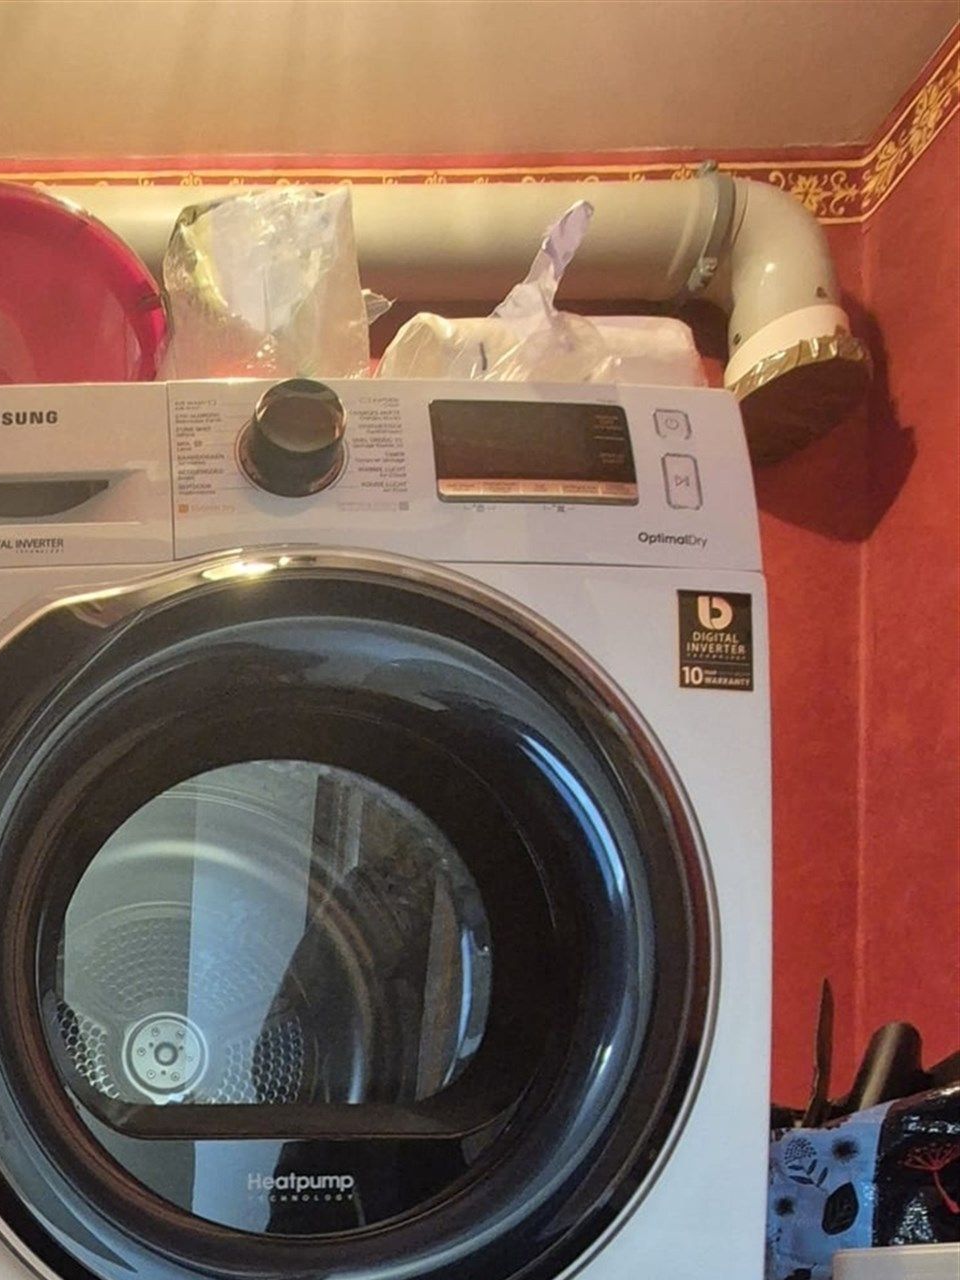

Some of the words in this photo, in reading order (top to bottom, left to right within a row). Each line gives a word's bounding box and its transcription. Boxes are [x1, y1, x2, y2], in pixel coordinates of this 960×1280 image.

[15, 537, 64, 549] INVERTER
[638, 531, 708, 549] OptimalDry
[692, 630, 739, 643] DIGITAL
[686, 641, 746, 655] INVERTER
[682, 666, 703, 685] 10
[704, 676, 750, 687] WARRANTY
[246, 1171, 355, 1193] Heatpump
